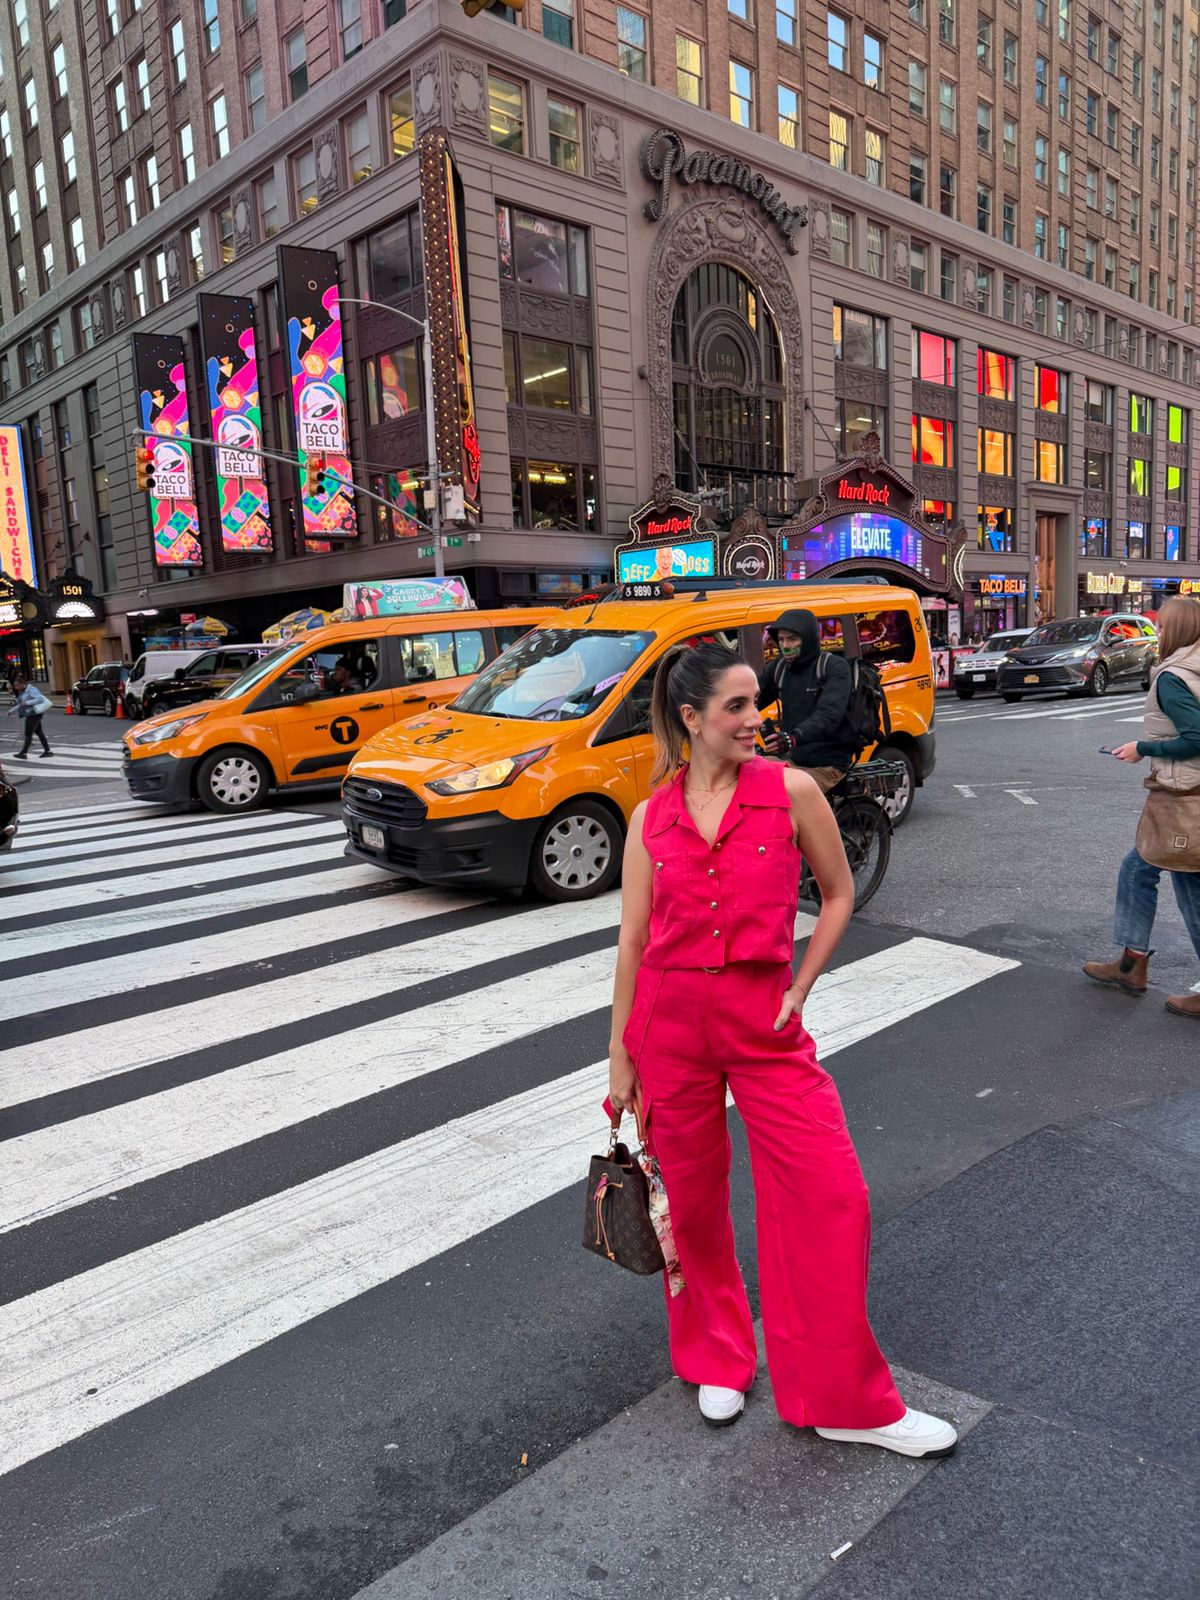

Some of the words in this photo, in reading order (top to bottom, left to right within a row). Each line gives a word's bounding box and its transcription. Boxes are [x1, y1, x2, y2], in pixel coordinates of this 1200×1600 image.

[641, 128, 808, 256] Paramount
[715, 352, 736, 368] 1501
[302, 422, 339, 435] TACO
[306, 435, 339, 448] BELL
[221, 450, 255, 462] TACO
[224, 462, 256, 473] BELL
[154, 475, 186, 485] TACO
[157, 485, 187, 495] BELL
[838, 480, 865, 499] Hard
[865, 483, 889, 506] Rock
[647, 519, 671, 534] Hard
[671, 515, 691, 533] Rock
[5, 487, 22, 580] SANDWICHE
[851, 527, 891, 550] ELEVATE
[736, 561, 751, 569] Hard
[752, 560, 765, 570] Rock
[624, 563, 650, 583] JEFF
[63, 585, 82, 596] 1501
[633, 585, 652, 597] 9B90
[979, 579, 1003, 593] TACO
[1004, 579, 1025, 593] BELL
